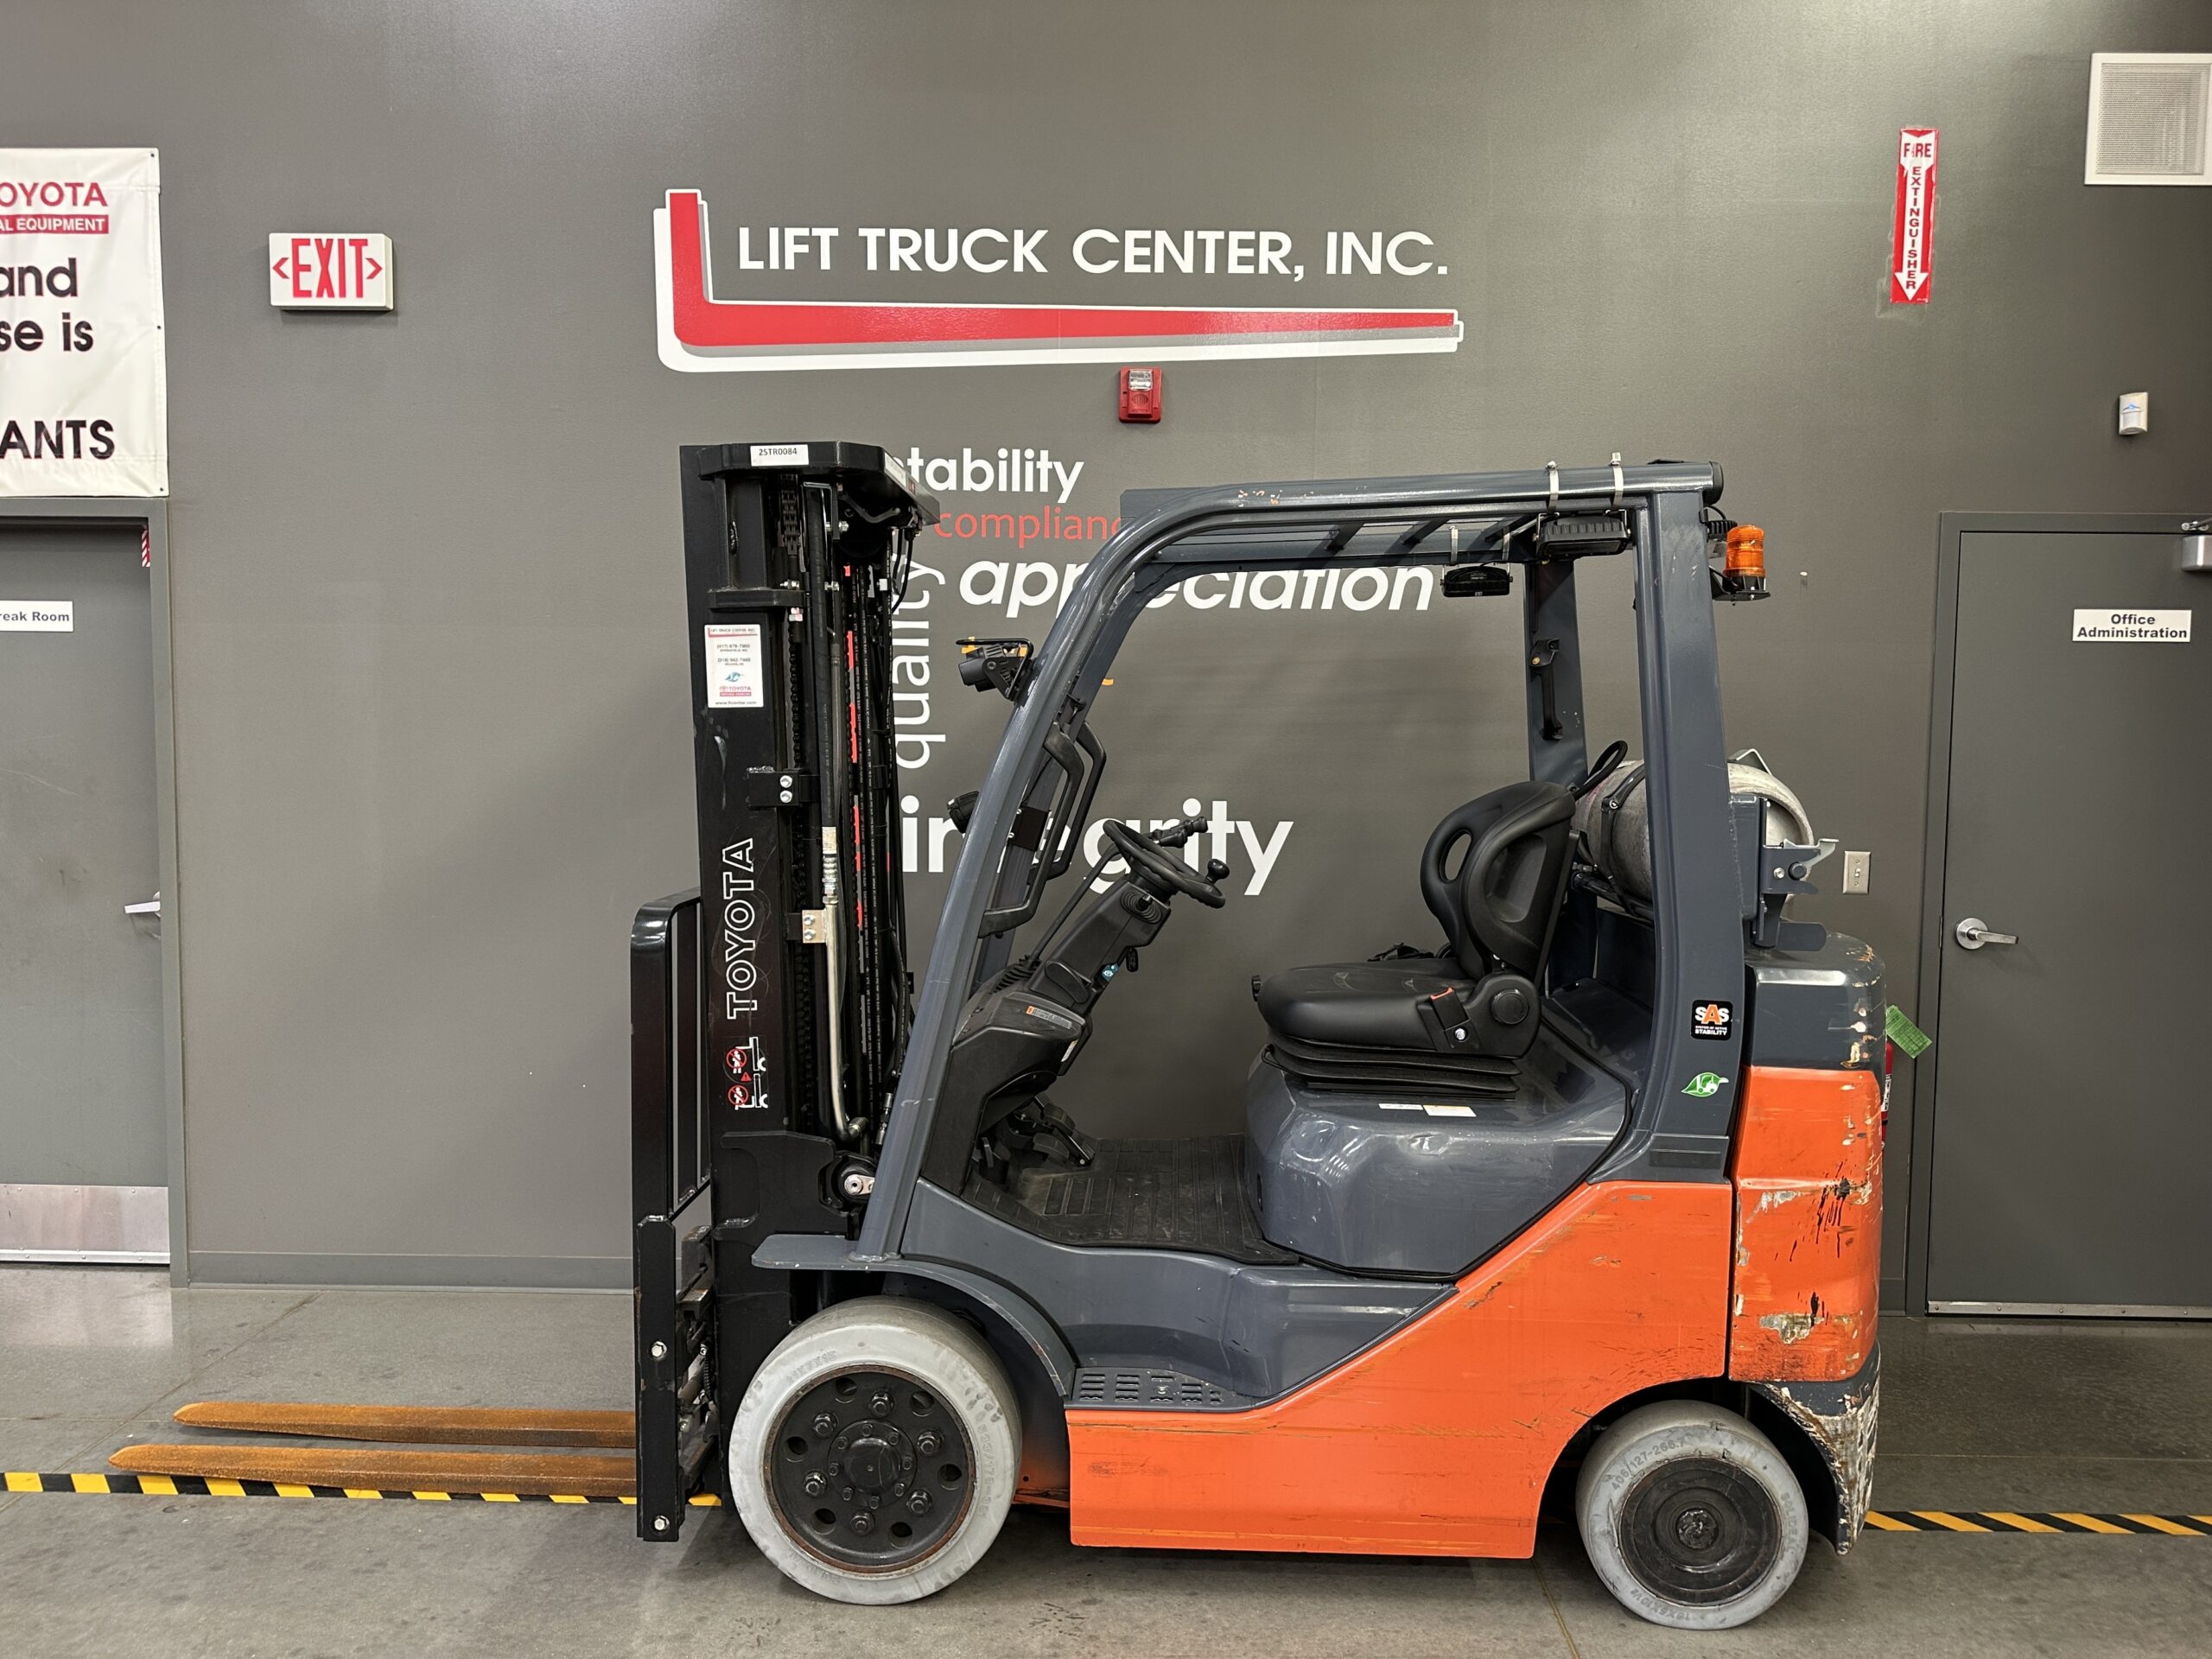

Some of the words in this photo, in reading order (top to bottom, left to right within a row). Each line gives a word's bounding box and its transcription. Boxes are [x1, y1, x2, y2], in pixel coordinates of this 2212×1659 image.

[16, 218, 105, 232] EQUIPMENT
[1905, 166, 1922, 289] EXTINGUISHER
[291, 238, 368, 298] EXIT
[737, 227, 840, 271] LIFT
[857, 227, 1048, 274] TRUCK
[1071, 228, 1306, 283] CENTER,
[1325, 232, 1450, 276] INC.
[62, 312, 93, 353] is
[0, 420, 116, 461] ANTS
[759, 448, 798, 456] 2STR0084
[893, 447, 1084, 504] tability
[934, 505, 1122, 549] complian
[32, 612, 70, 622] Room
[2077, 626, 2187, 639] Administration
[2111, 613, 2156, 625] Office
[722, 837, 758, 1020] TOYOTA
[1694, 1004, 1730, 1025] SAS
